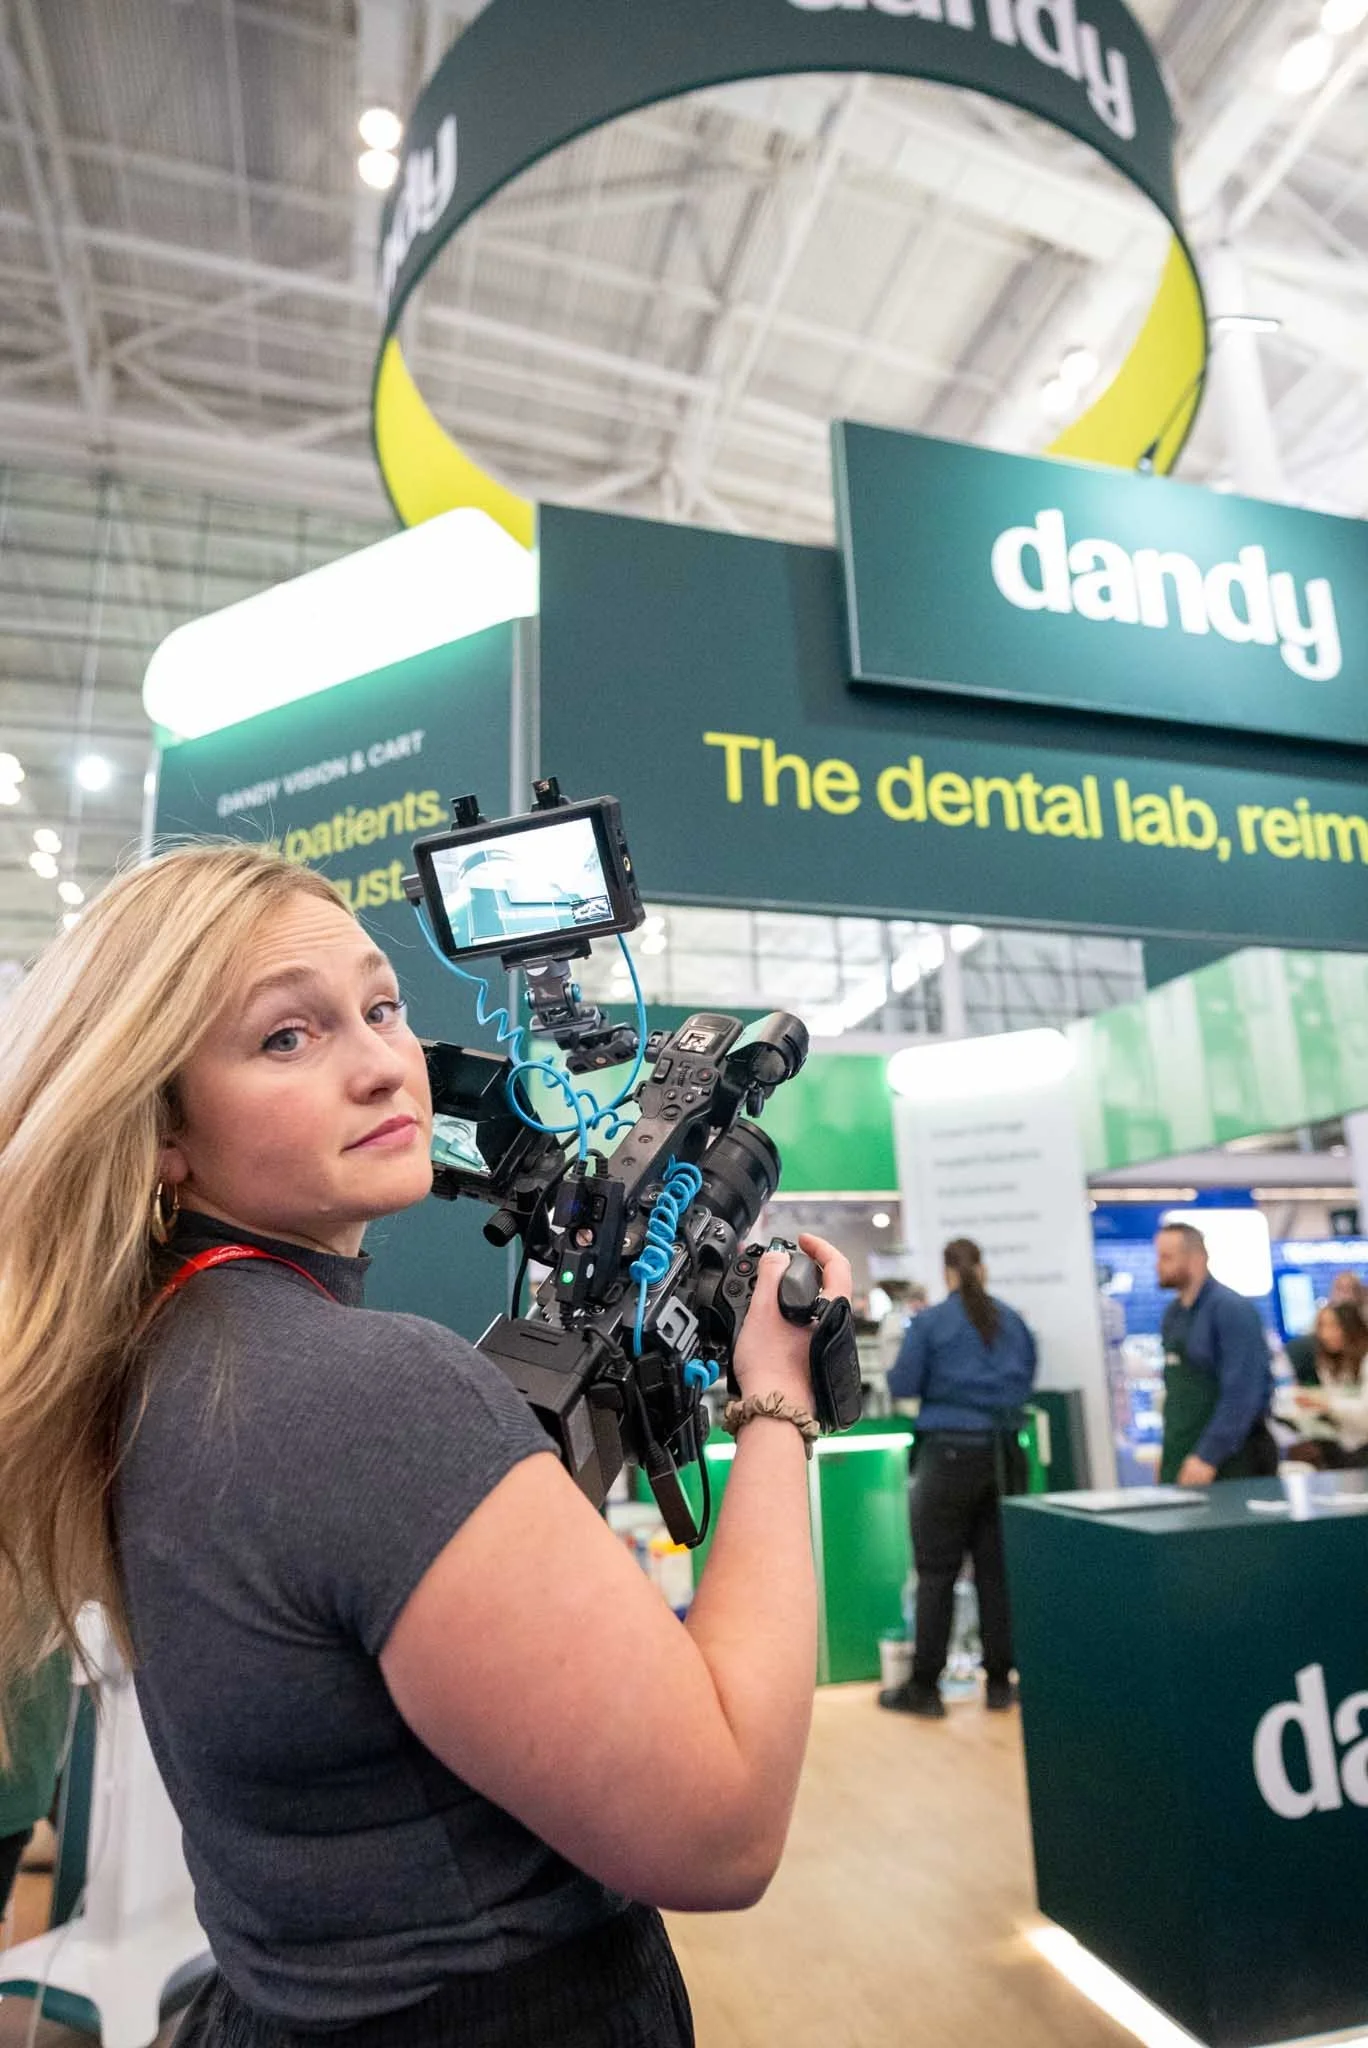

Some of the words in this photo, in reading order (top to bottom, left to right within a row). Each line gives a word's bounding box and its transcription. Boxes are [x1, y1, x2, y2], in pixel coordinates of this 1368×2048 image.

[786, 0, 1136, 140] ndy
[990, 508, 1342, 682] dandy
[367, 729, 426, 768] CART
[703, 731, 861, 816] The
[876, 755, 1103, 840] dental
[1113, 778, 1233, 863] lab,
[285, 790, 449, 864] patients.
